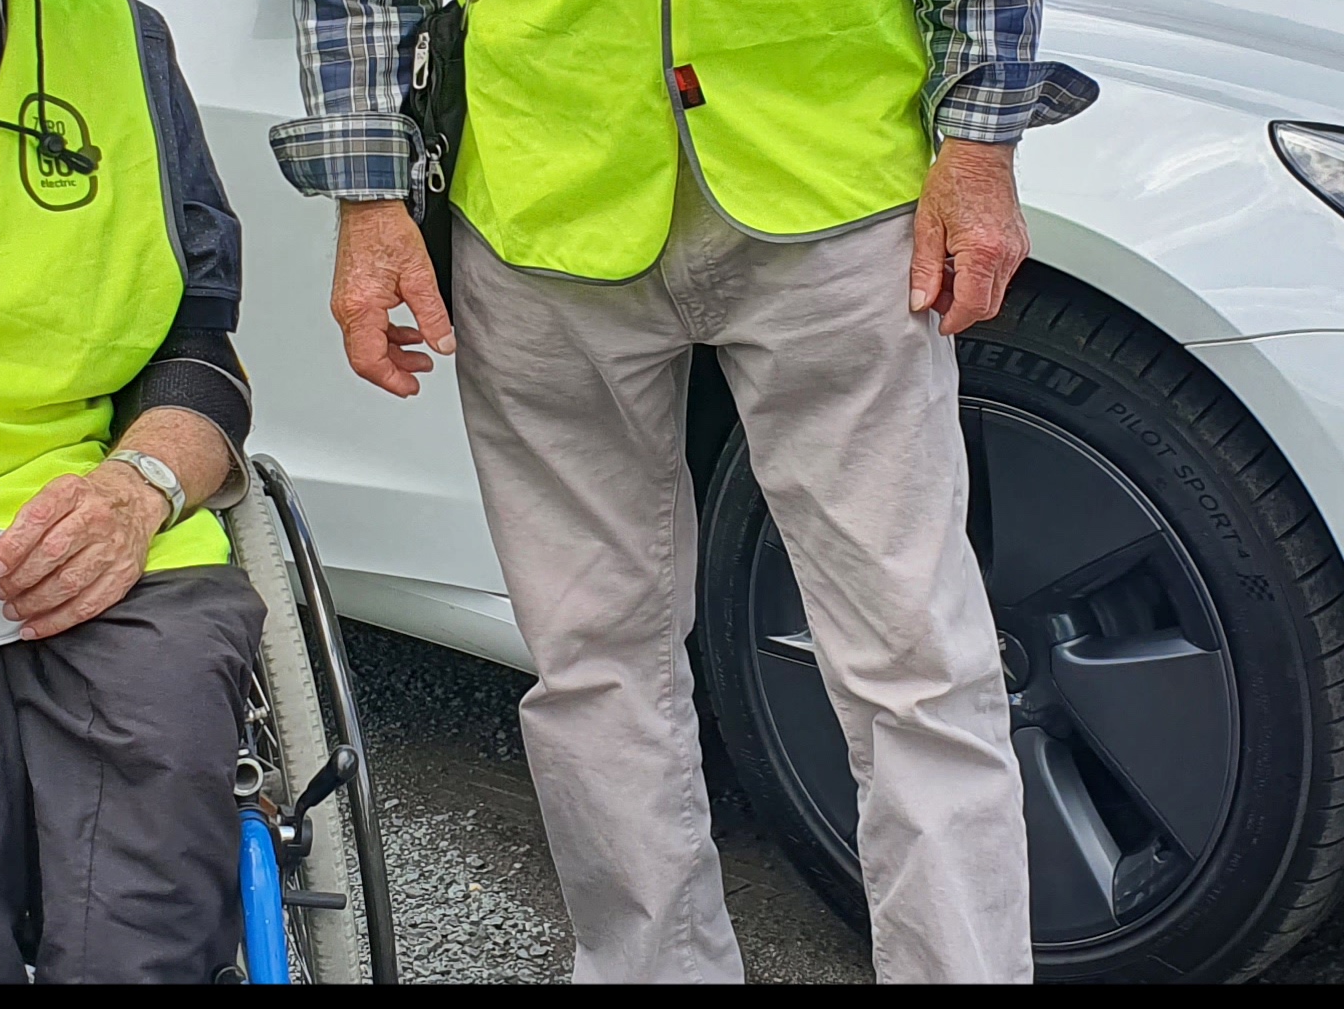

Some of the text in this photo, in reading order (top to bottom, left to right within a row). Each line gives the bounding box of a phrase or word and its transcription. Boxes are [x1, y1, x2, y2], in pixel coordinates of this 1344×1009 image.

[32, 116, 66, 136] ZRO
[40, 178, 77, 188] electric
[958, 340, 1084, 396] HELIN
[1105, 402, 1177, 457] PILOT
[1174, 465, 1242, 544] SPORT
